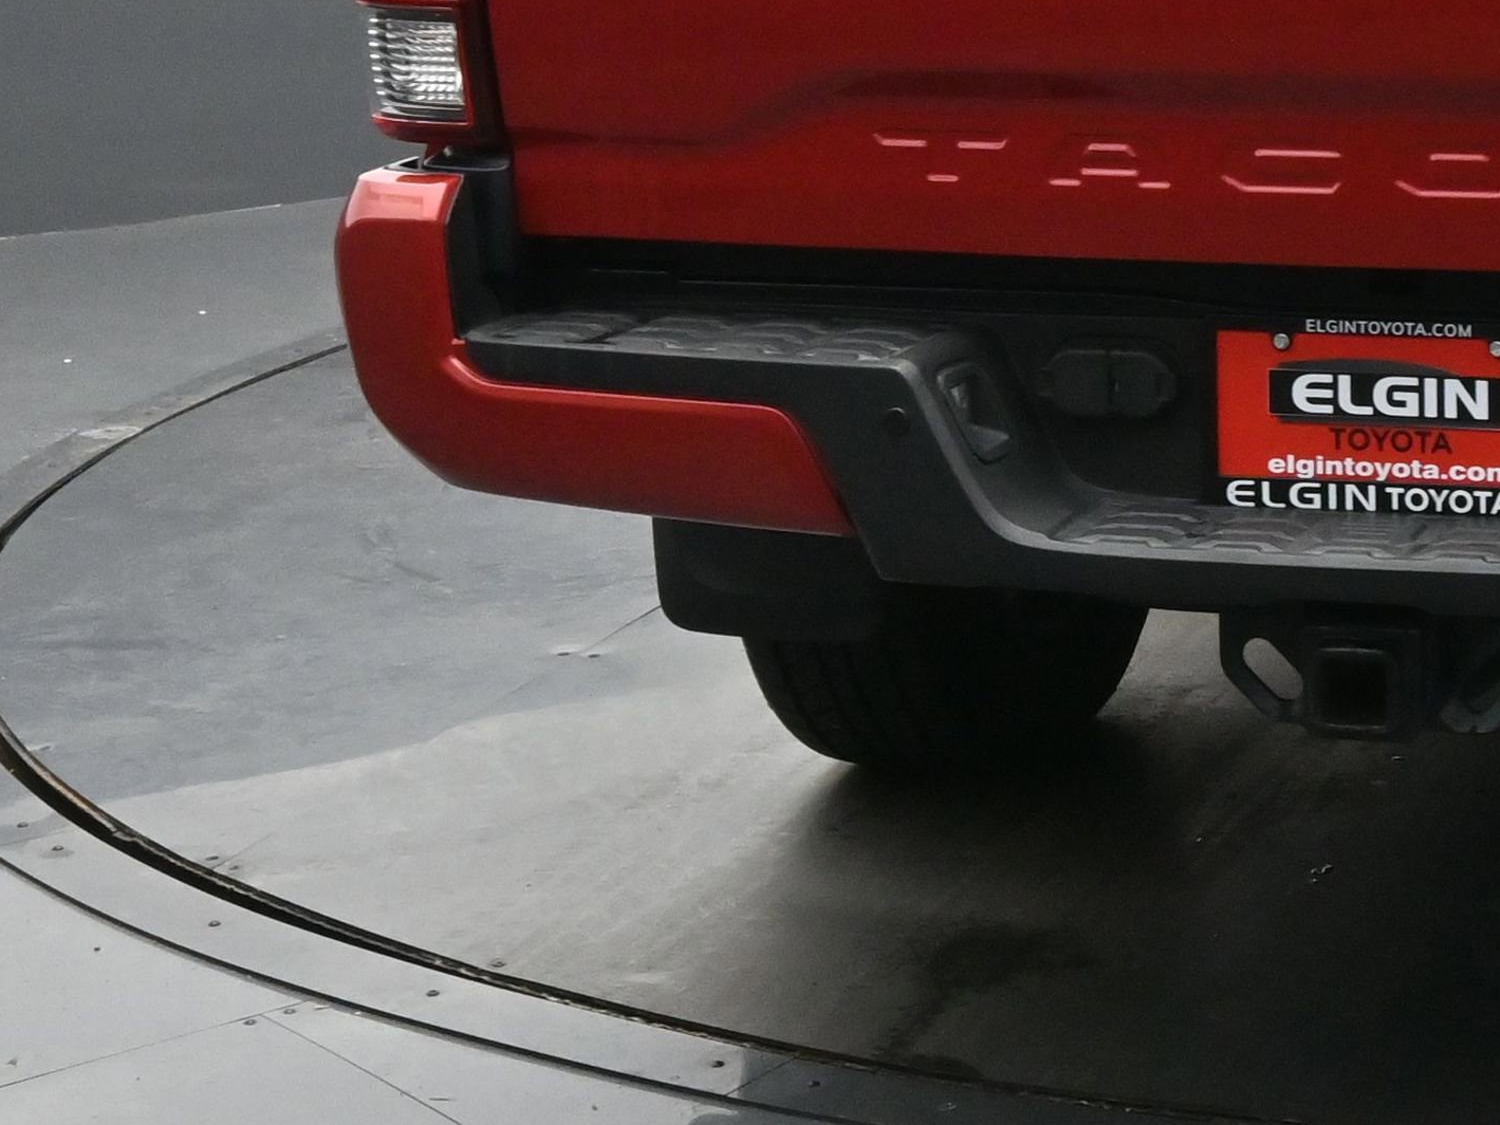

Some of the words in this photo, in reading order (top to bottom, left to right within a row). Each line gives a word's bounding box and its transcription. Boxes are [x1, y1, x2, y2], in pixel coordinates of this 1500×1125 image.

[1305, 319, 1473, 338] ELGINTOYOTA.COM
[1291, 373, 1490, 421] ELGIN
[1330, 427, 1453, 455] TOYOTA
[1225, 479, 1377, 512] ELGIN
